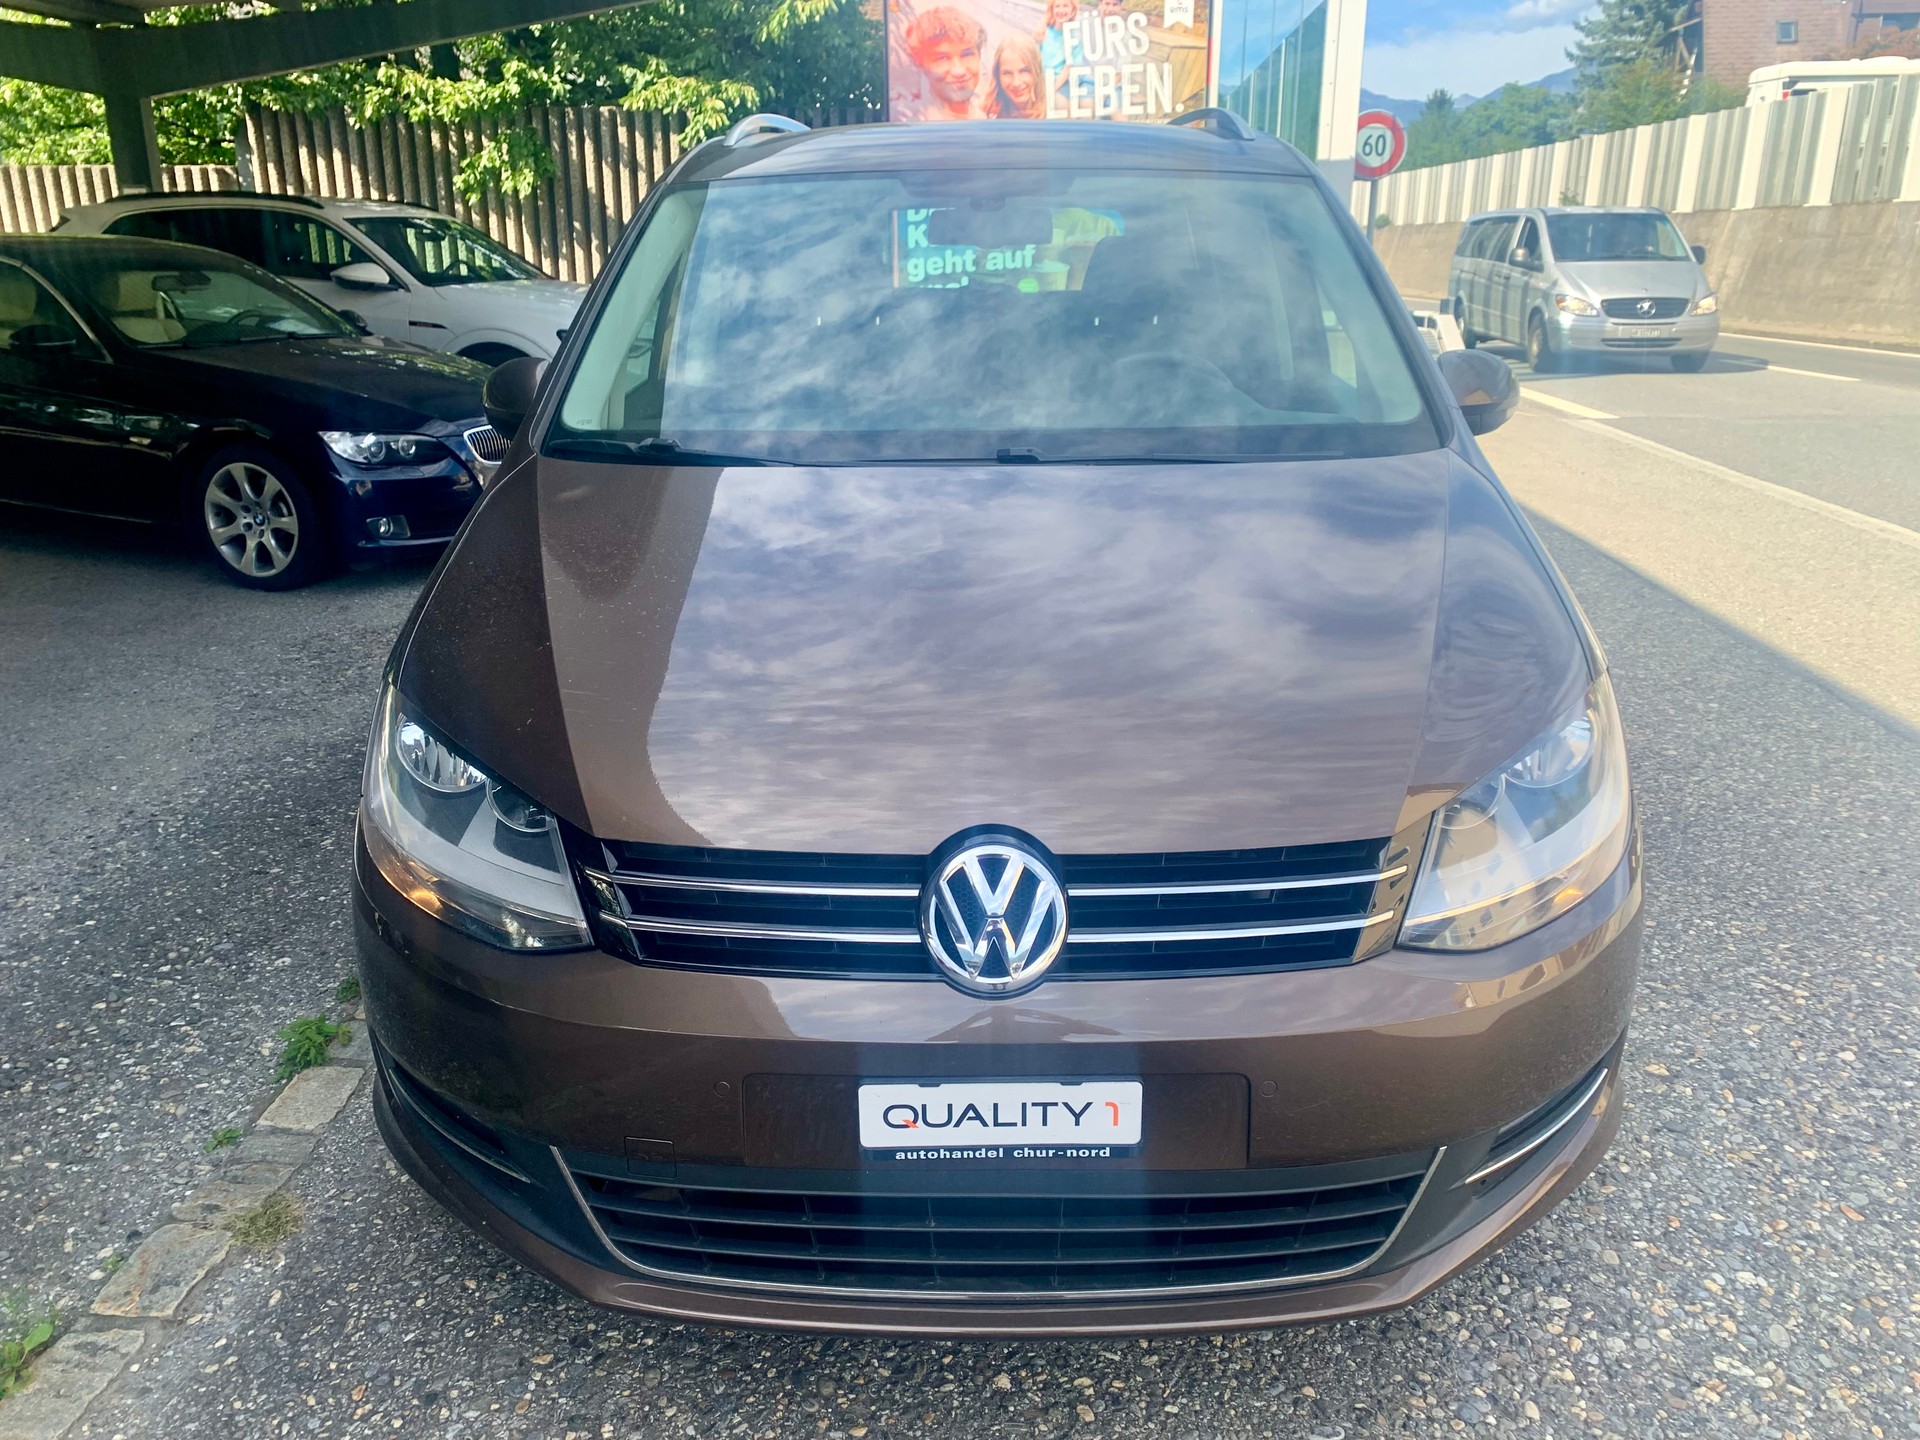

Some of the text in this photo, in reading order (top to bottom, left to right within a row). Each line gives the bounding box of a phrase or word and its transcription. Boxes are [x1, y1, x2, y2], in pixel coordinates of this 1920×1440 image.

[1062, 10, 1150, 65] FÜRS
[1045, 62, 1185, 119] LEBEN.
[1362, 134, 1386, 157] 60
[907, 249, 977, 282] geht
[985, 244, 1036, 271] auf
[882, 1101, 1119, 1129] QUALITY 1
[895, 1147, 1111, 1160] autohandel chur-nord
